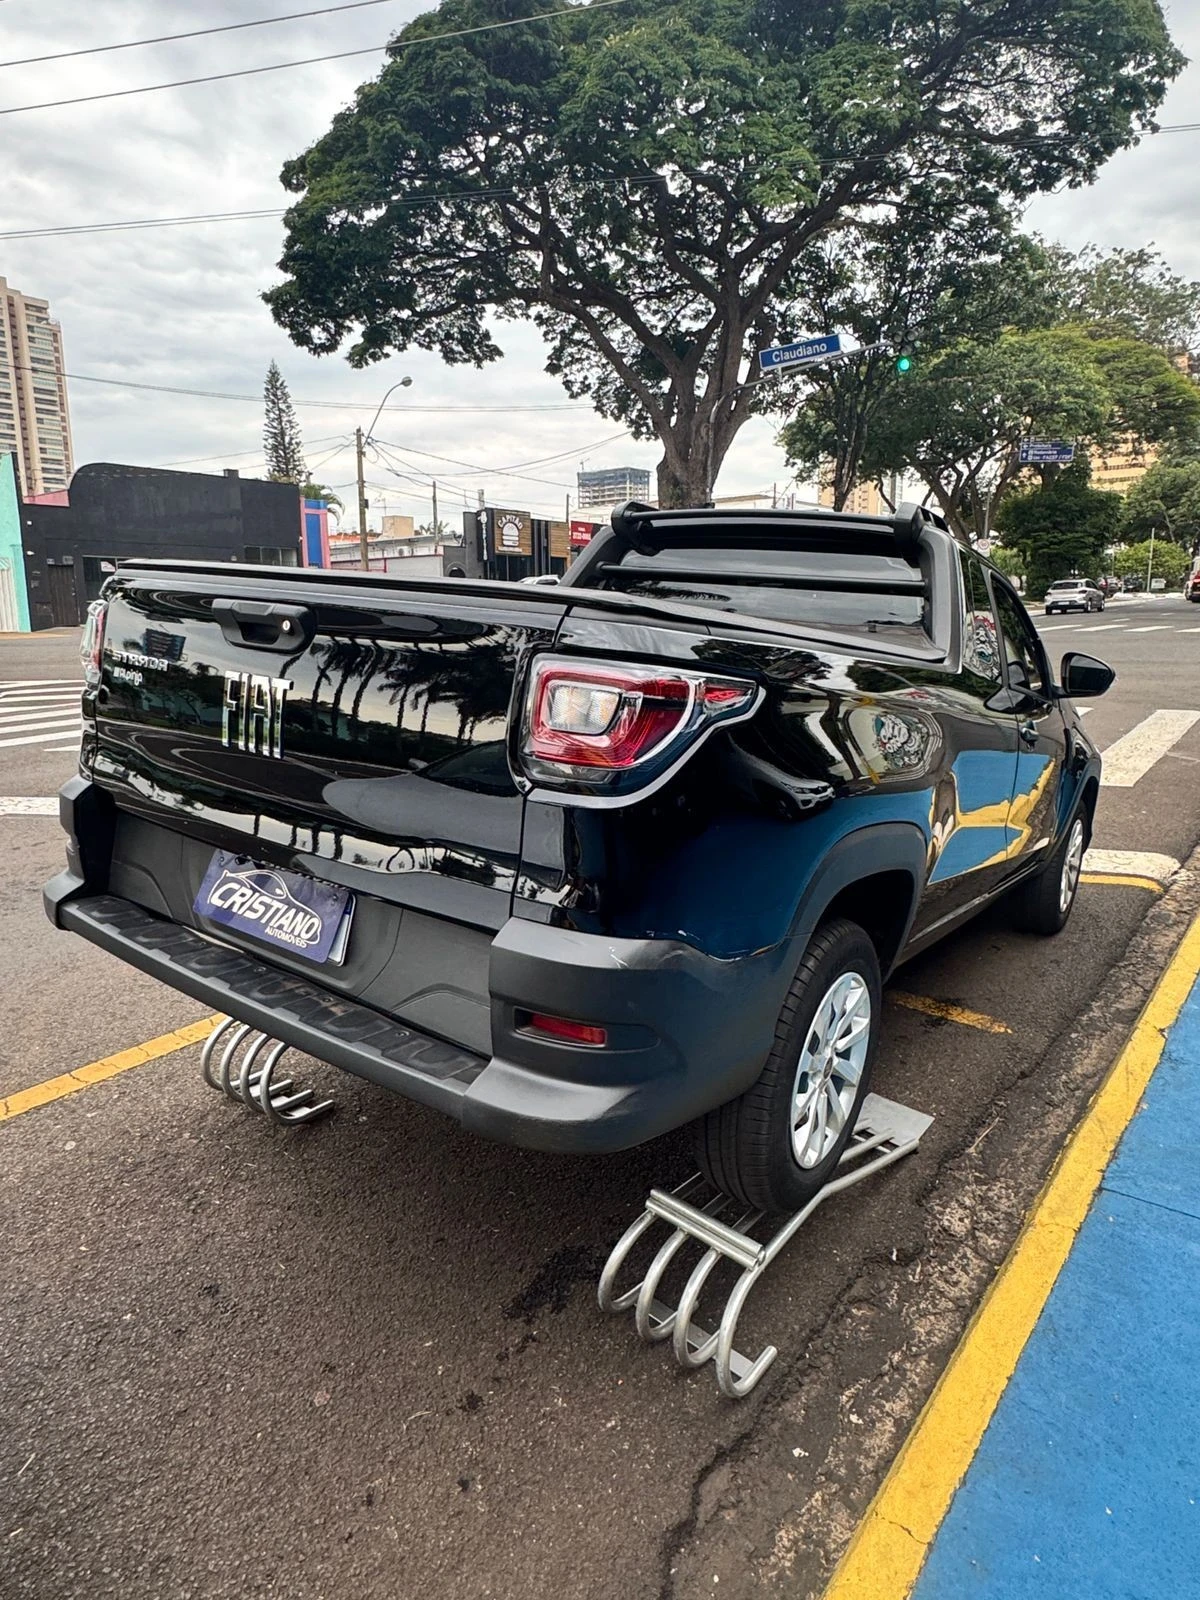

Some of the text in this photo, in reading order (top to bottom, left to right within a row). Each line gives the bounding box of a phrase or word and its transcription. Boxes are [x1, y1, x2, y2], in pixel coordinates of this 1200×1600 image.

[772, 343, 827, 362] Claudiano
[222, 670, 294, 760] FIAT
[210, 882, 319, 940] CRISTIANO
